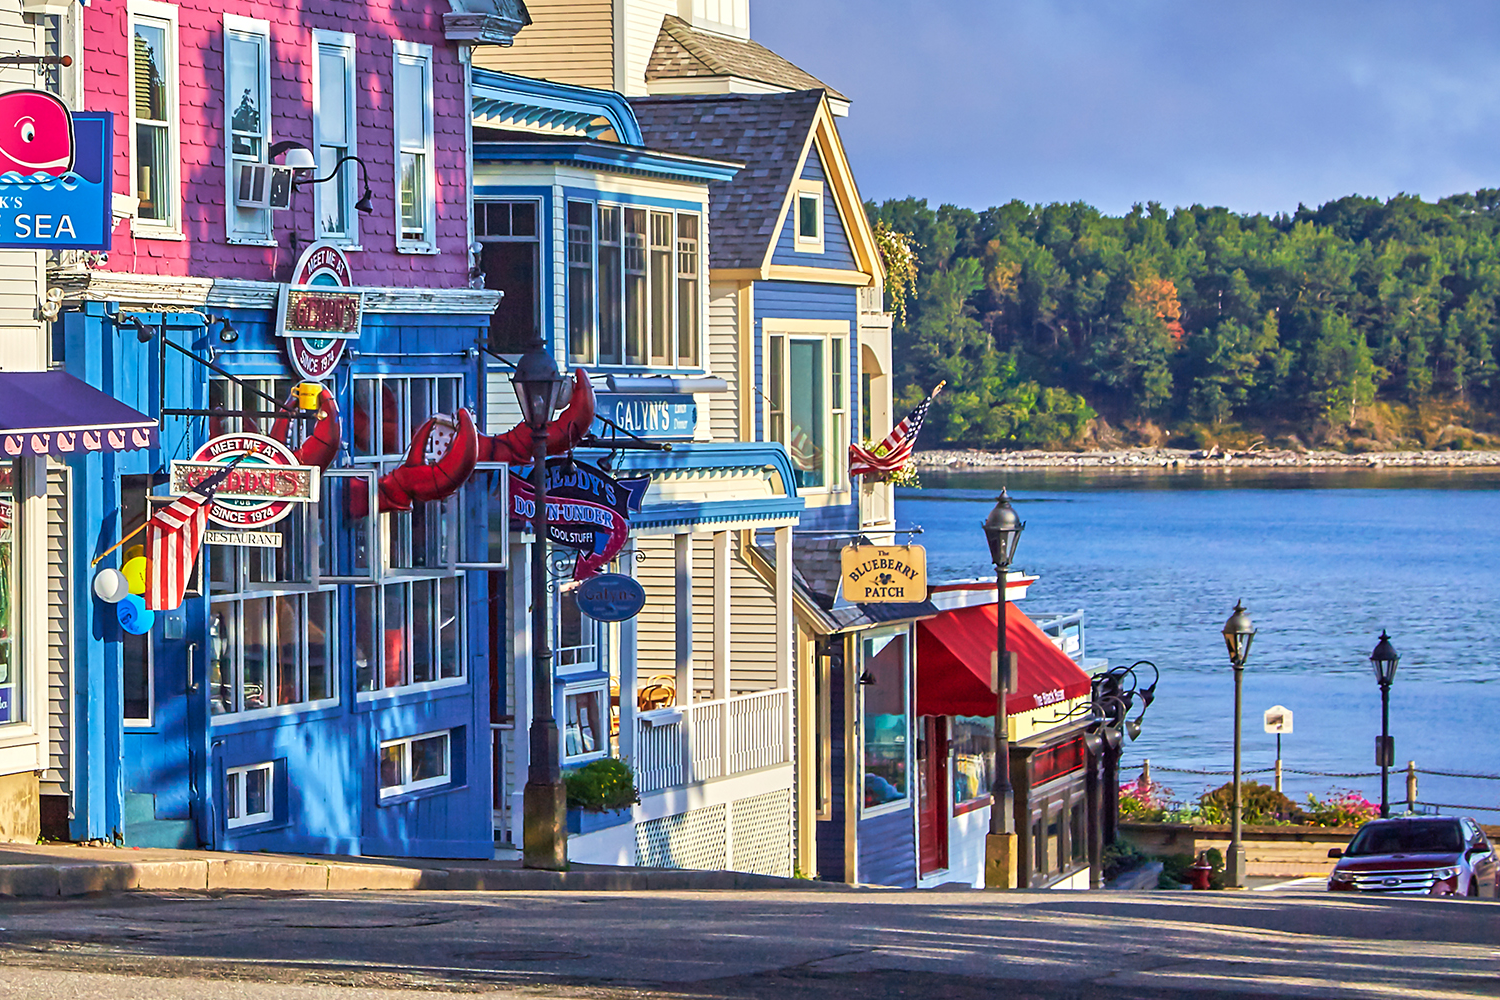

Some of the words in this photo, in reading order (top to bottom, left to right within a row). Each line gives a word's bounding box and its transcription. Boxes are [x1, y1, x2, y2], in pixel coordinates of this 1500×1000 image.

[14, 214, 77, 239] SEA
[307, 251, 325, 275] MEET
[326, 251, 336, 267] ME
[335, 263, 345, 276] AT
[300, 350, 319, 373] SINCE
[320, 354, 335, 372] 1974
[616, 401, 670, 431] GALYN'S
[210, 438, 242, 456] MEET
[243, 439, 261, 451] ME
[262, 446, 279, 458] AT
[187, 470, 299, 497] GDDY'S
[212, 506, 246, 523] SINCE
[250, 508, 274, 522] 1974
[514, 495, 614, 529] DON-UNDER
[205, 532, 280, 545] RESTAURANT
[550, 526, 570, 542] COOL
[570, 532, 593, 543] STUFF!
[849, 559, 919, 583] BLUEBERRY
[865, 587, 904, 597] PATCH
